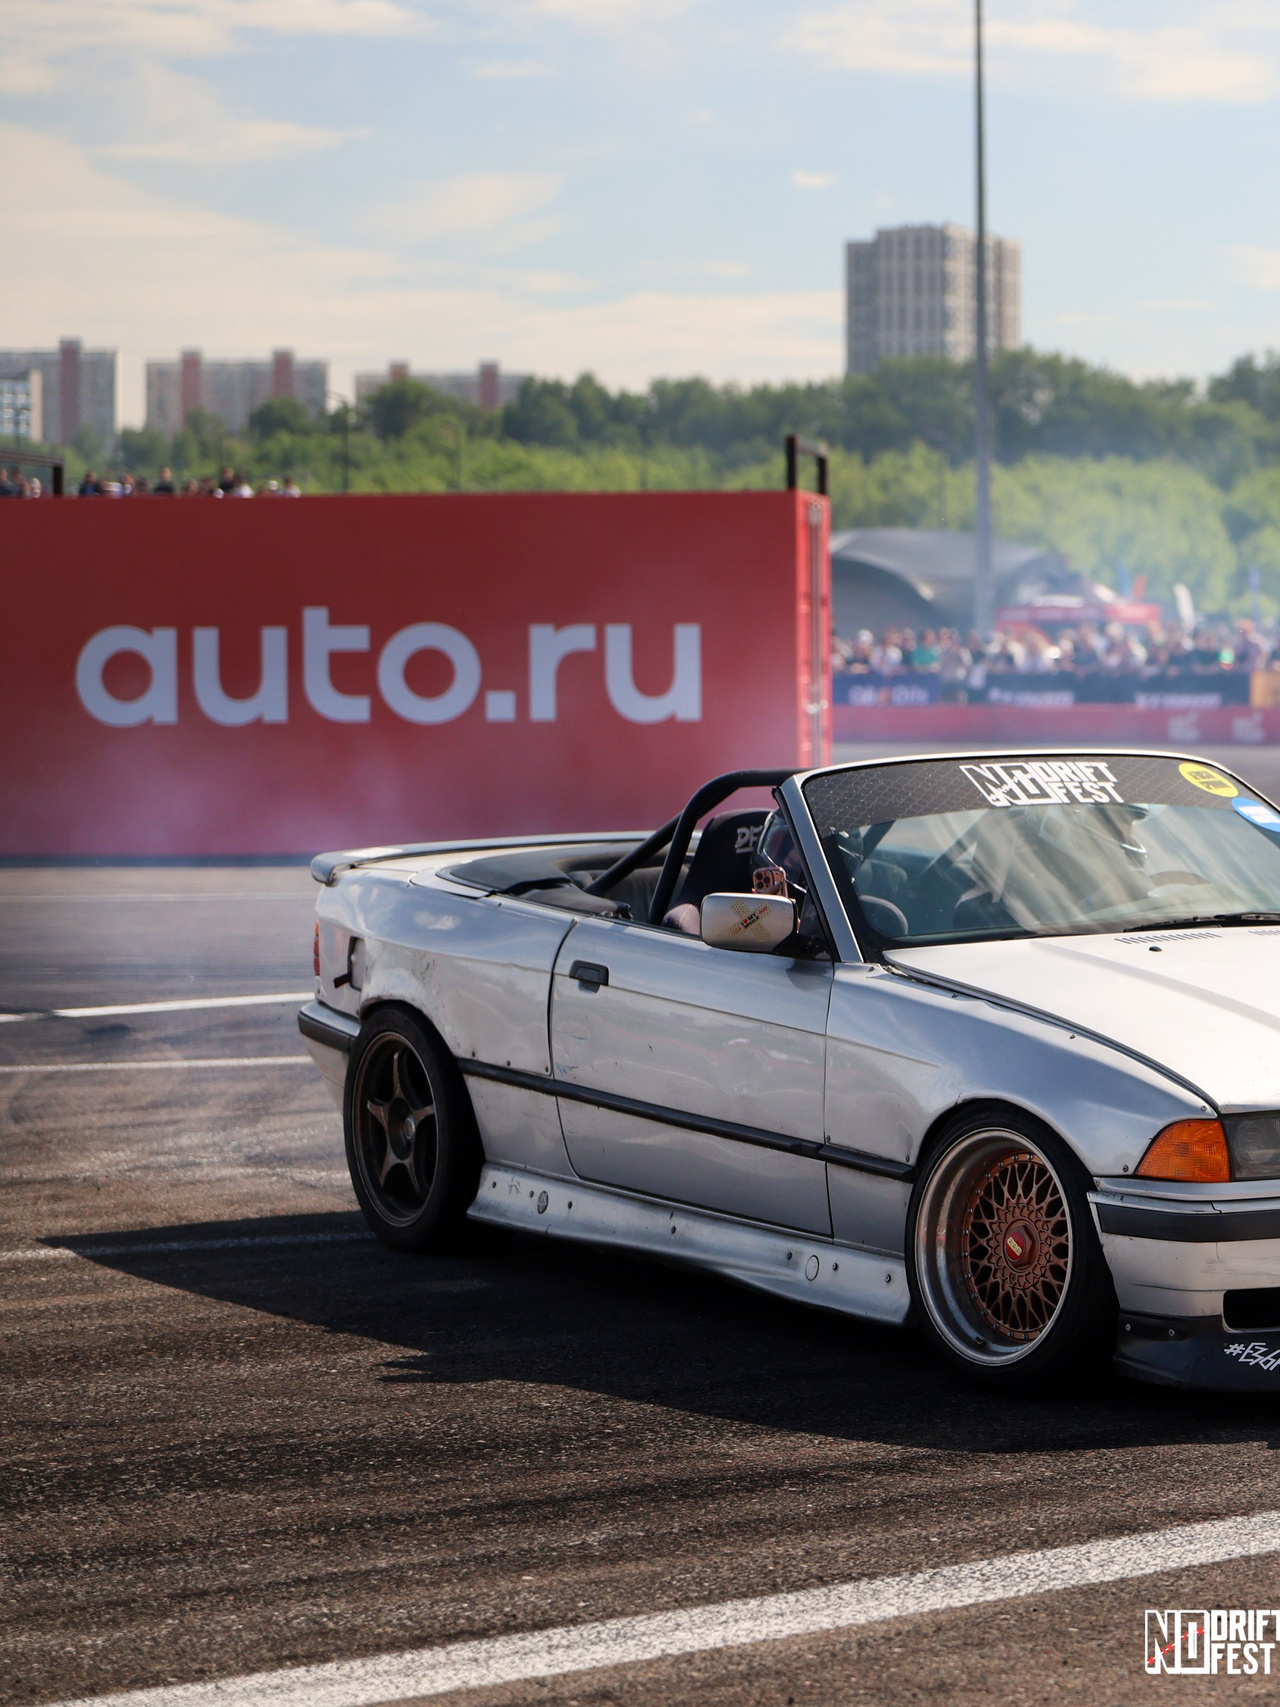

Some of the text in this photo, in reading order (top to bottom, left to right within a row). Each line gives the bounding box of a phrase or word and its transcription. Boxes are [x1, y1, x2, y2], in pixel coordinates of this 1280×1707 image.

[75, 606, 703, 727] auto.ru
[1028, 761, 1118, 782] DRIFT
[1046, 782, 1125, 803] FEST
